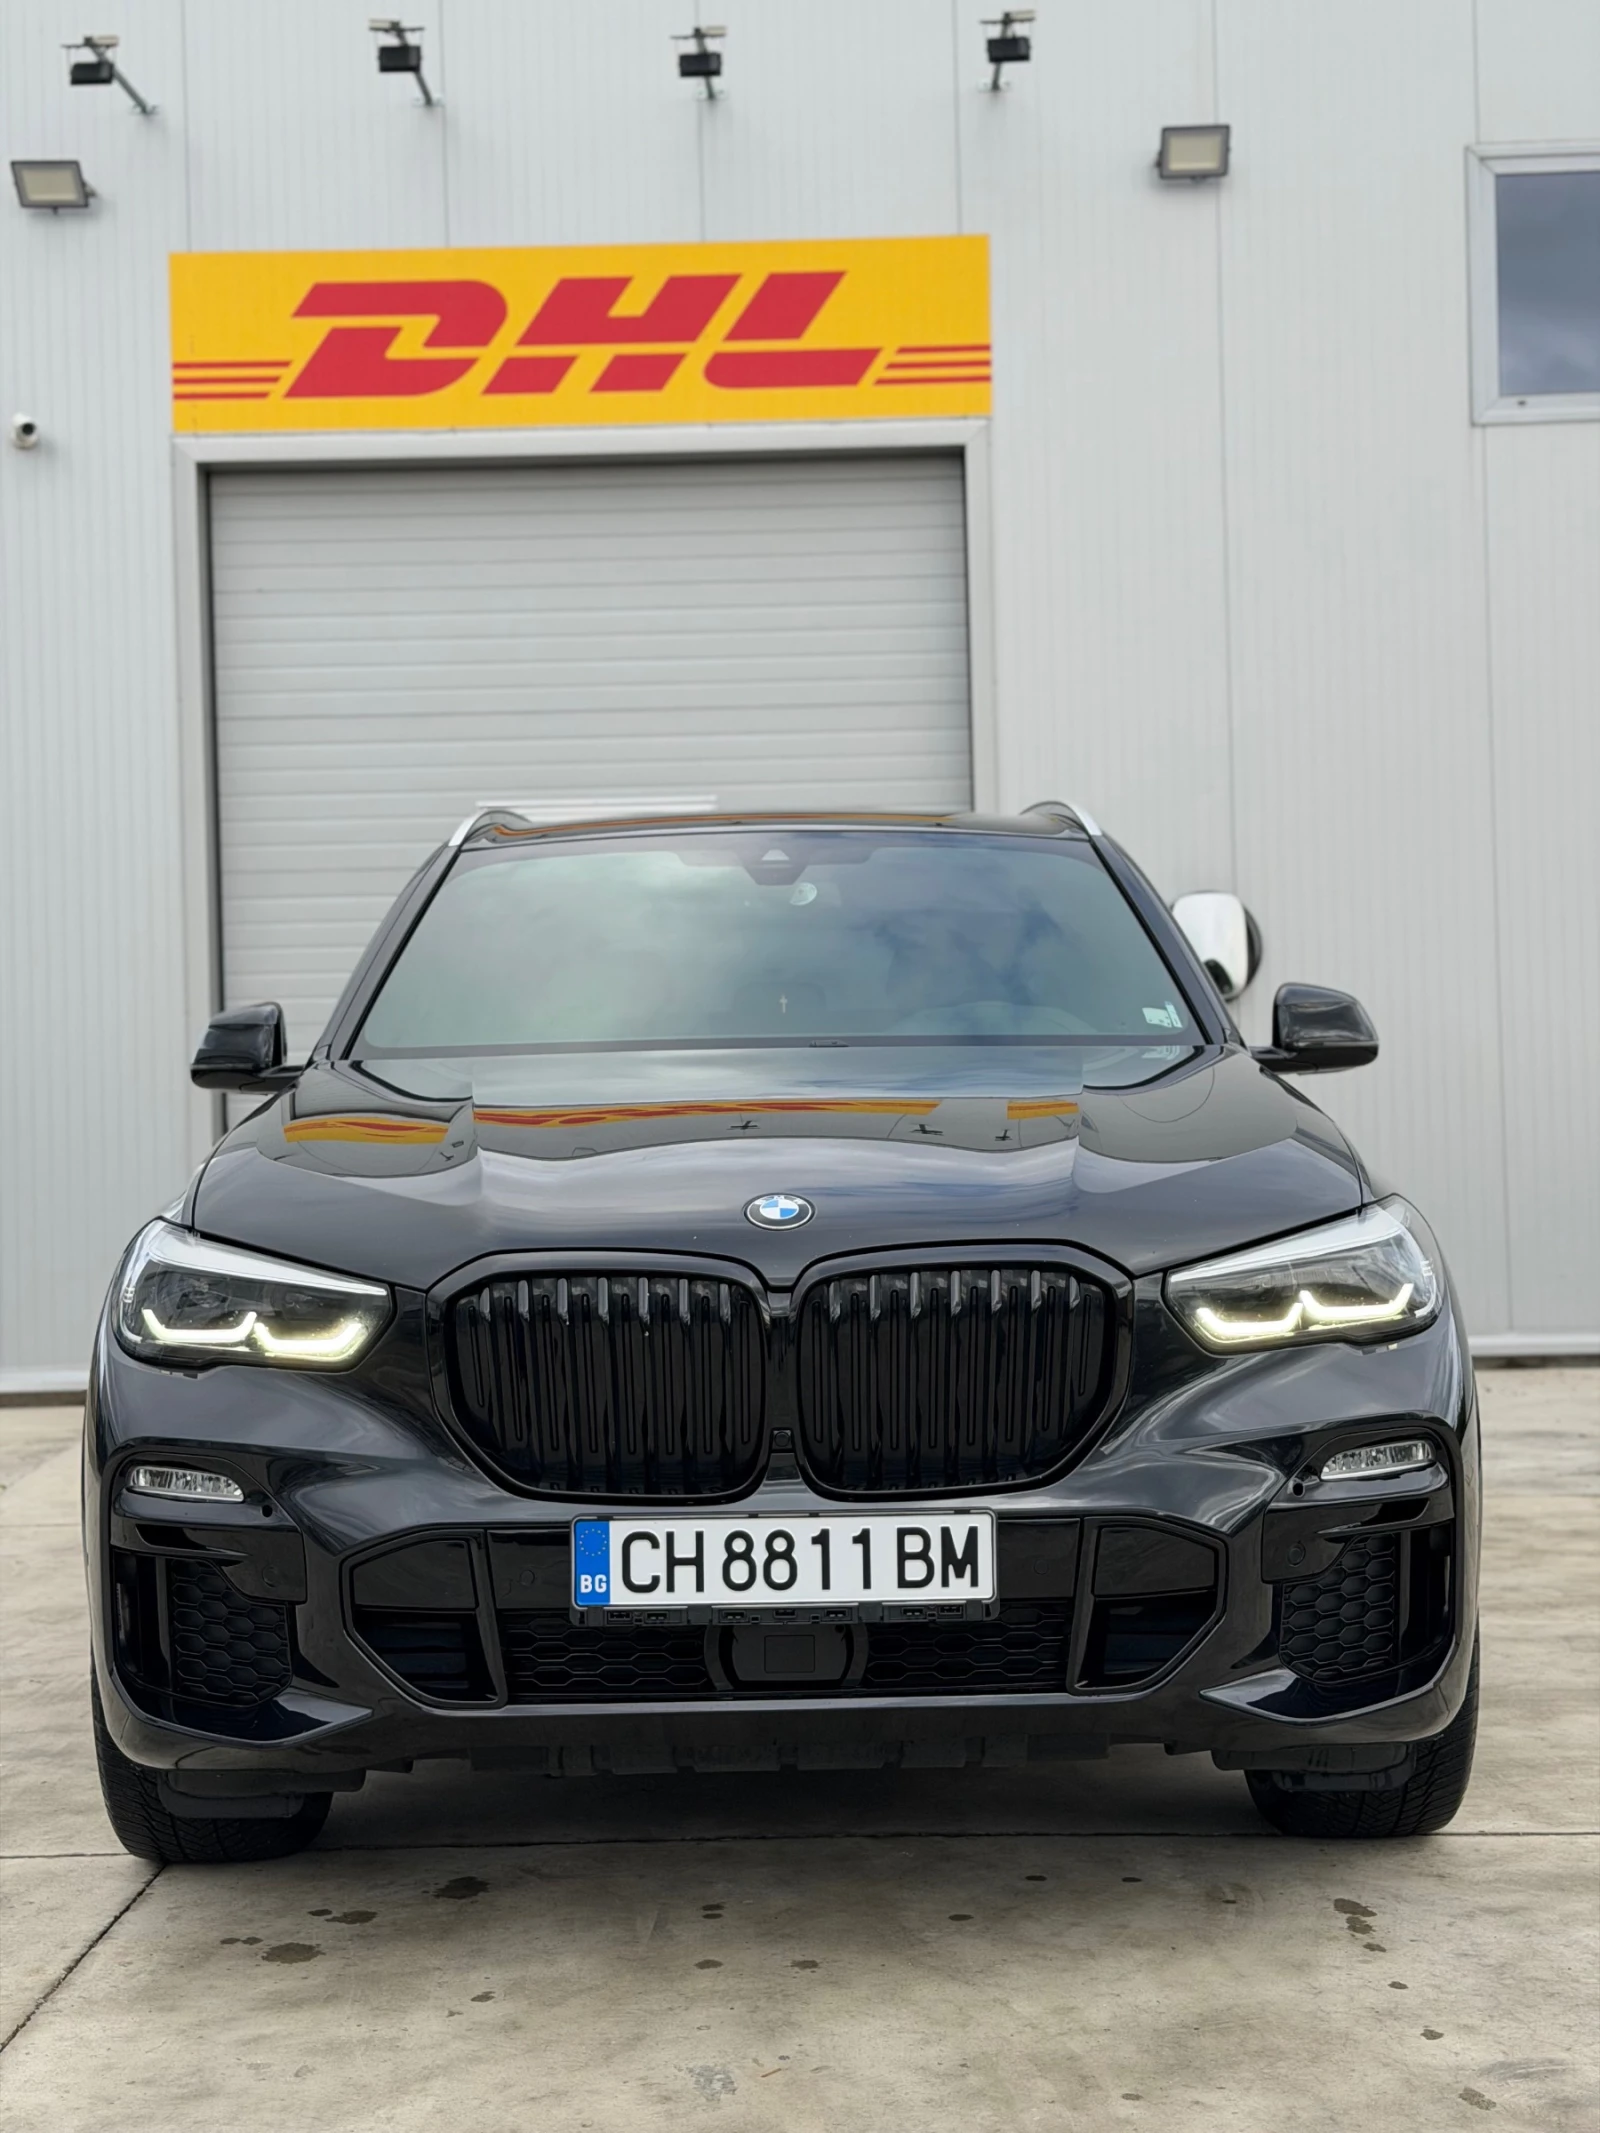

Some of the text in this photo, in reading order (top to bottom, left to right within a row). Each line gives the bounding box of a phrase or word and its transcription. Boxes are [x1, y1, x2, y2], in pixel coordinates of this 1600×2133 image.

[283, 271, 885, 398] DHL
[580, 1574, 607, 1593] BG
[621, 1525, 979, 1593] CH 8811 BM
